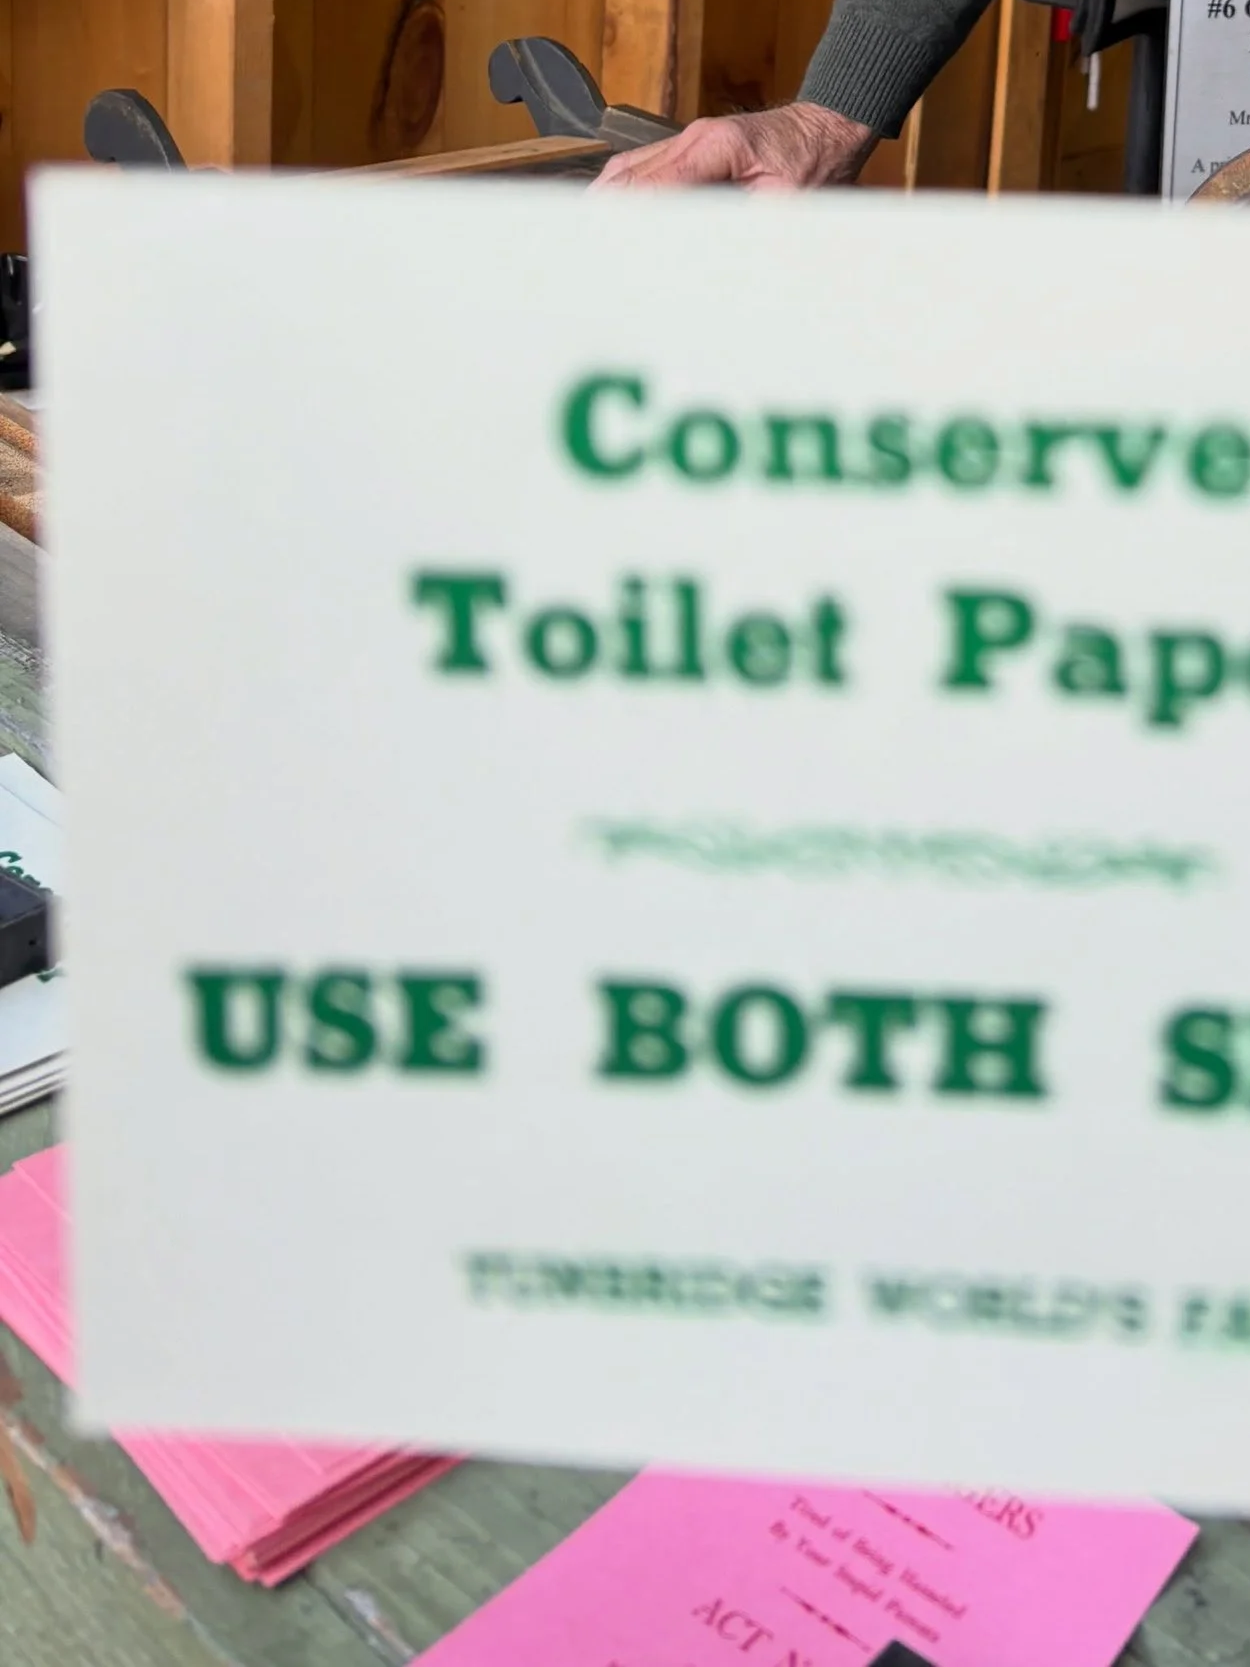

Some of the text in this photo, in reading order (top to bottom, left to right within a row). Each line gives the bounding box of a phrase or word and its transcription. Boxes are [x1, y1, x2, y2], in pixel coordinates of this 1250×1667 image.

[1190, 159, 1206, 174] A
[411, 571, 848, 690] Toilet
[186, 968, 485, 1076] USE
[596, 978, 1049, 1102] BOTH
[466, 1253, 828, 1324] TUNBRIDGE
[689, 1596, 776, 1654] ACT
